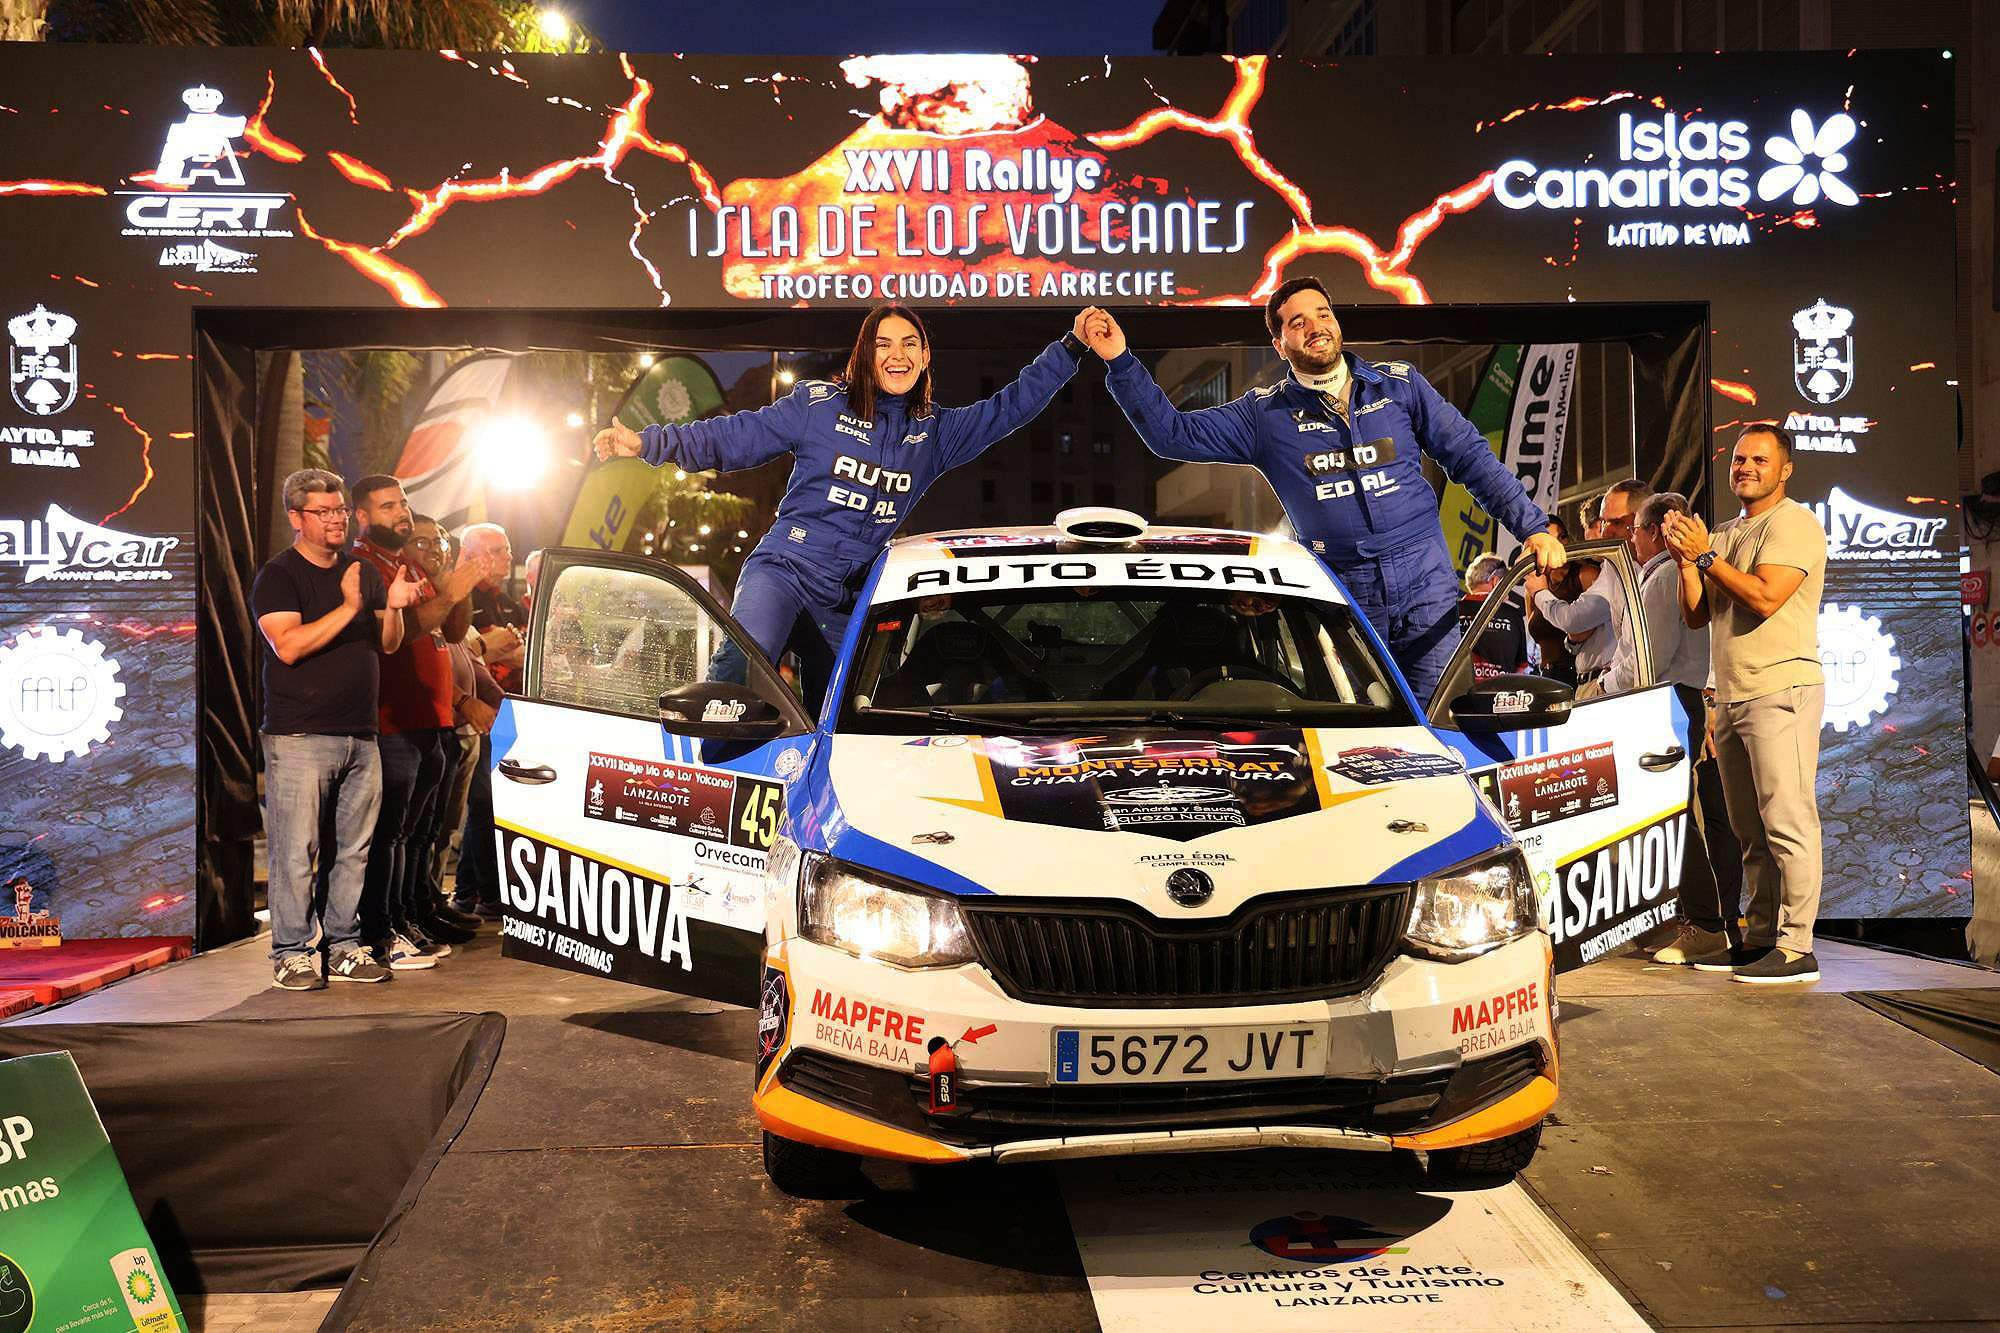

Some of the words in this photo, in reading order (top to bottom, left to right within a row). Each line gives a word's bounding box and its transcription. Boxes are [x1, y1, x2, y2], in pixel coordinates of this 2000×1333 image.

[1619, 112, 1751, 162] Islas
[844, 148, 950, 193] XXVII
[965, 147, 1101, 205] Rallye
[1493, 159, 1751, 210] Canarias
[125, 196, 287, 229] CERT
[688, 204, 800, 259] ISLA
[818, 204, 877, 258] DE
[897, 202, 989, 258] LOS
[1004, 199, 1255, 257] VOLCANES
[1607, 222, 1680, 248] LATITUD
[1683, 223, 1706, 246] DE
[1709, 221, 1752, 247] VIDA
[761, 272, 873, 300] TROFEO
[879, 272, 990, 299] CIUDAD
[996, 272, 1030, 298] DE
[1041, 269, 1176, 298] ARRECIFE
[839, 414, 873, 429] AUTO
[833, 455, 912, 494] AUTO
[1312, 445, 1378, 472] AUTO
[0, 517, 179, 568] allycar
[906, 562, 1097, 592] AUTO
[1126, 558, 1311, 589] ÉDAL
[590, 754, 617, 770] XXVII
[617, 759, 644, 776] Rallye
[662, 767, 675, 779] de
[677, 769, 692, 782] Los
[695, 772, 734, 789] Volcanes
[1010, 768, 1119, 787] CHAPA
[1130, 768, 1150, 777] Y
[1157, 767, 1297, 781] PINTURA
[1018, 758, 1285, 778] MONTSERRAT
[1500, 765, 1524, 781] XXVII
[623, 785, 690, 807] LANZAROTE
[1535, 774, 1589, 798] LANZAROTE
[740, 783, 780, 848] 45
[1131, 805, 1178, 814] Andrés
[1181, 806, 1190, 815] y
[694, 841, 766, 871] Orvecam
[1140, 853, 1187, 862] AUTO
[1192, 850, 1236, 861] ÉDAL
[1579, 909, 1655, 963] CONSTRUCCIONES
[1652, 906, 1663, 926] Y
[546, 930, 557, 950] Y
[555, 933, 615, 975] REFORMAS
[810, 988, 926, 1046] MAPFRE
[1450, 982, 1539, 1035] MAPFRE
[815, 1021, 864, 1053] BREÑA
[868, 1038, 911, 1066] BAJA
[1461, 1026, 1506, 1055] BREÑA
[1509, 1017, 1536, 1042] BAJA
[1062, 1062, 1073, 1073] E
[1090, 1033, 1210, 1077] 5672
[1227, 1030, 1316, 1072] JVT
[0, 1175, 61, 1213] mas
[133, 1255, 146, 1267] bp
[1200, 1268, 1338, 1282] Centros
[1349, 1265, 1390, 1278] de
[1400, 1264, 1483, 1277] Arte,
[1193, 1278, 1328, 1295] Cultura
[1336, 1281, 1355, 1293] y
[1360, 1276, 1505, 1290] Turismo
[1275, 1293, 1444, 1307] LANZAROTE
